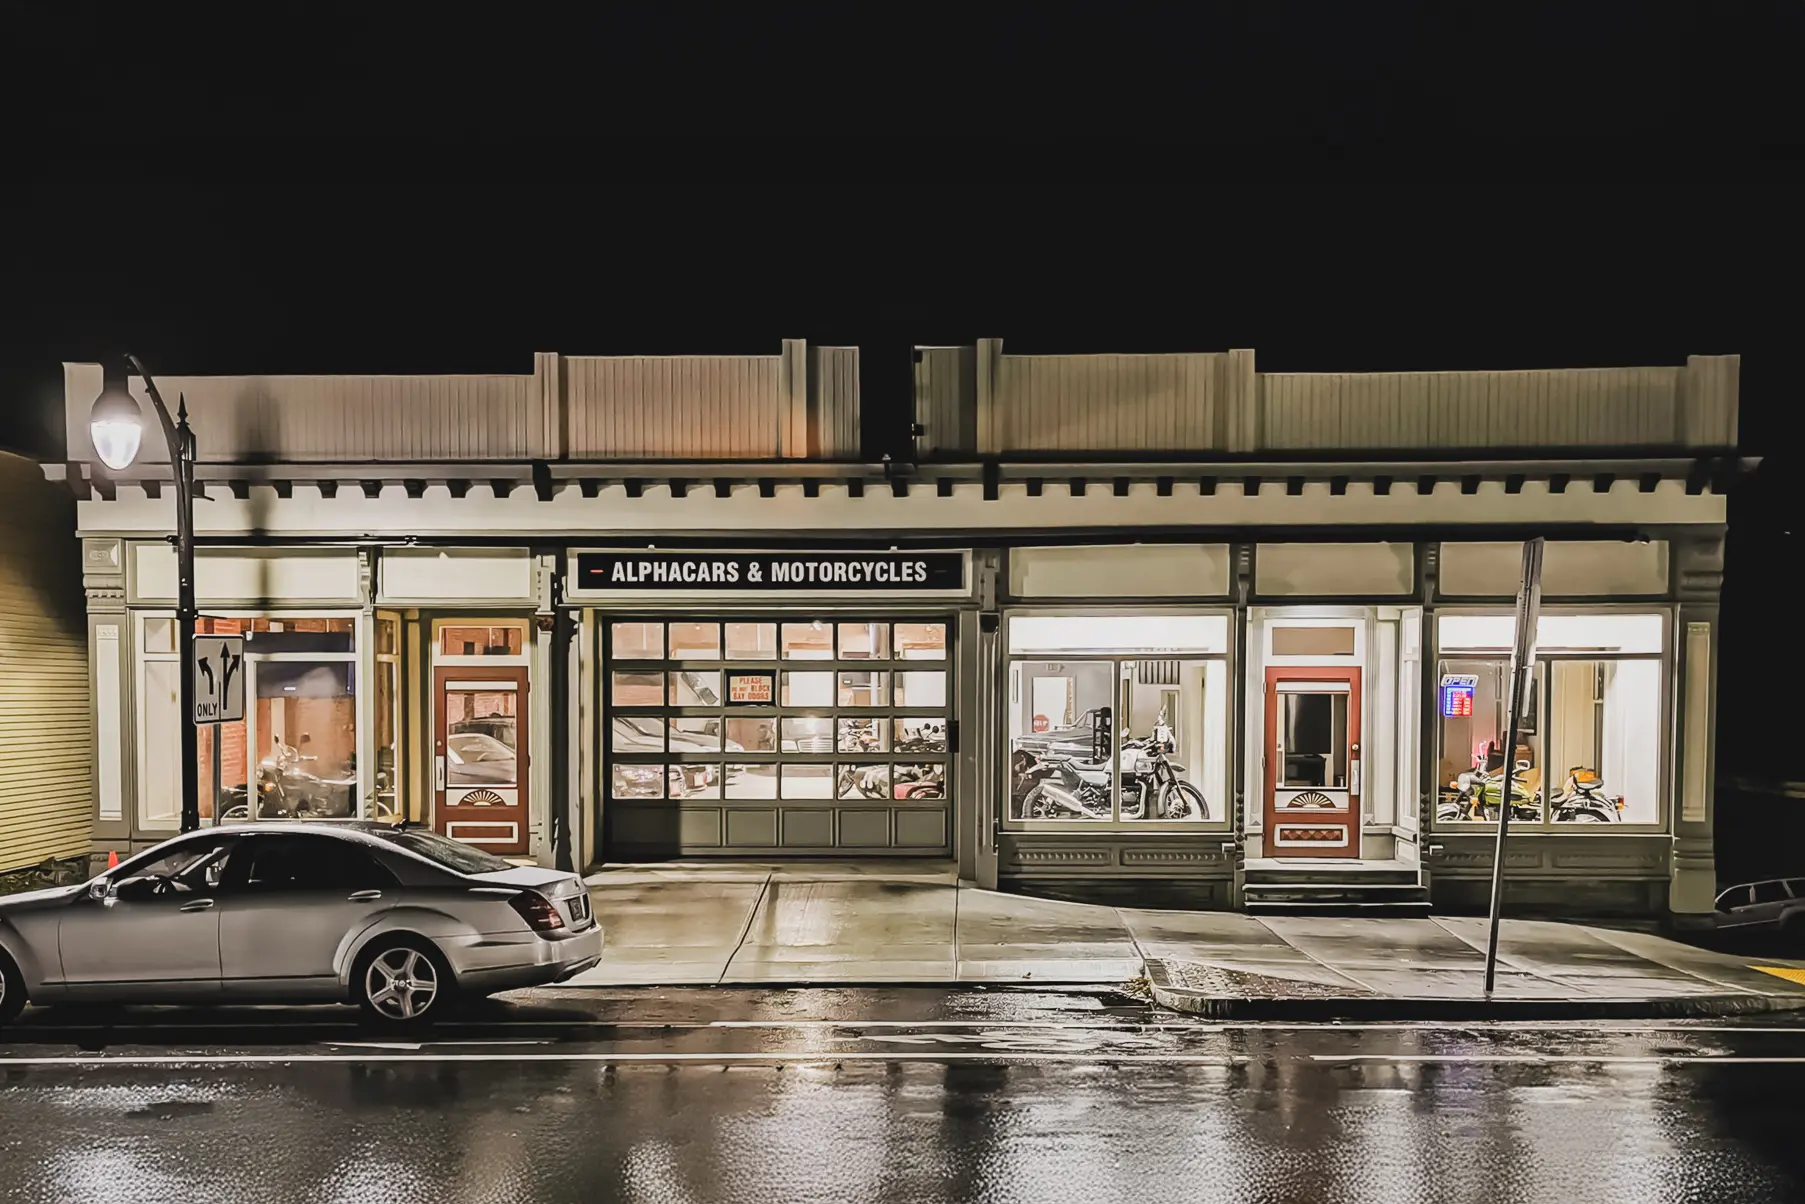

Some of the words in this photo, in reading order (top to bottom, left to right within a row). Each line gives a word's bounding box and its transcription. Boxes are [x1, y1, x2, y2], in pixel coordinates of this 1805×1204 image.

[611, 561, 740, 582] ALPHACARS
[747, 561, 763, 582] &
[771, 561, 927, 582] MOTORCYCLES
[1444, 676, 1476, 686] OPEN
[197, 702, 217, 717] ONLY
